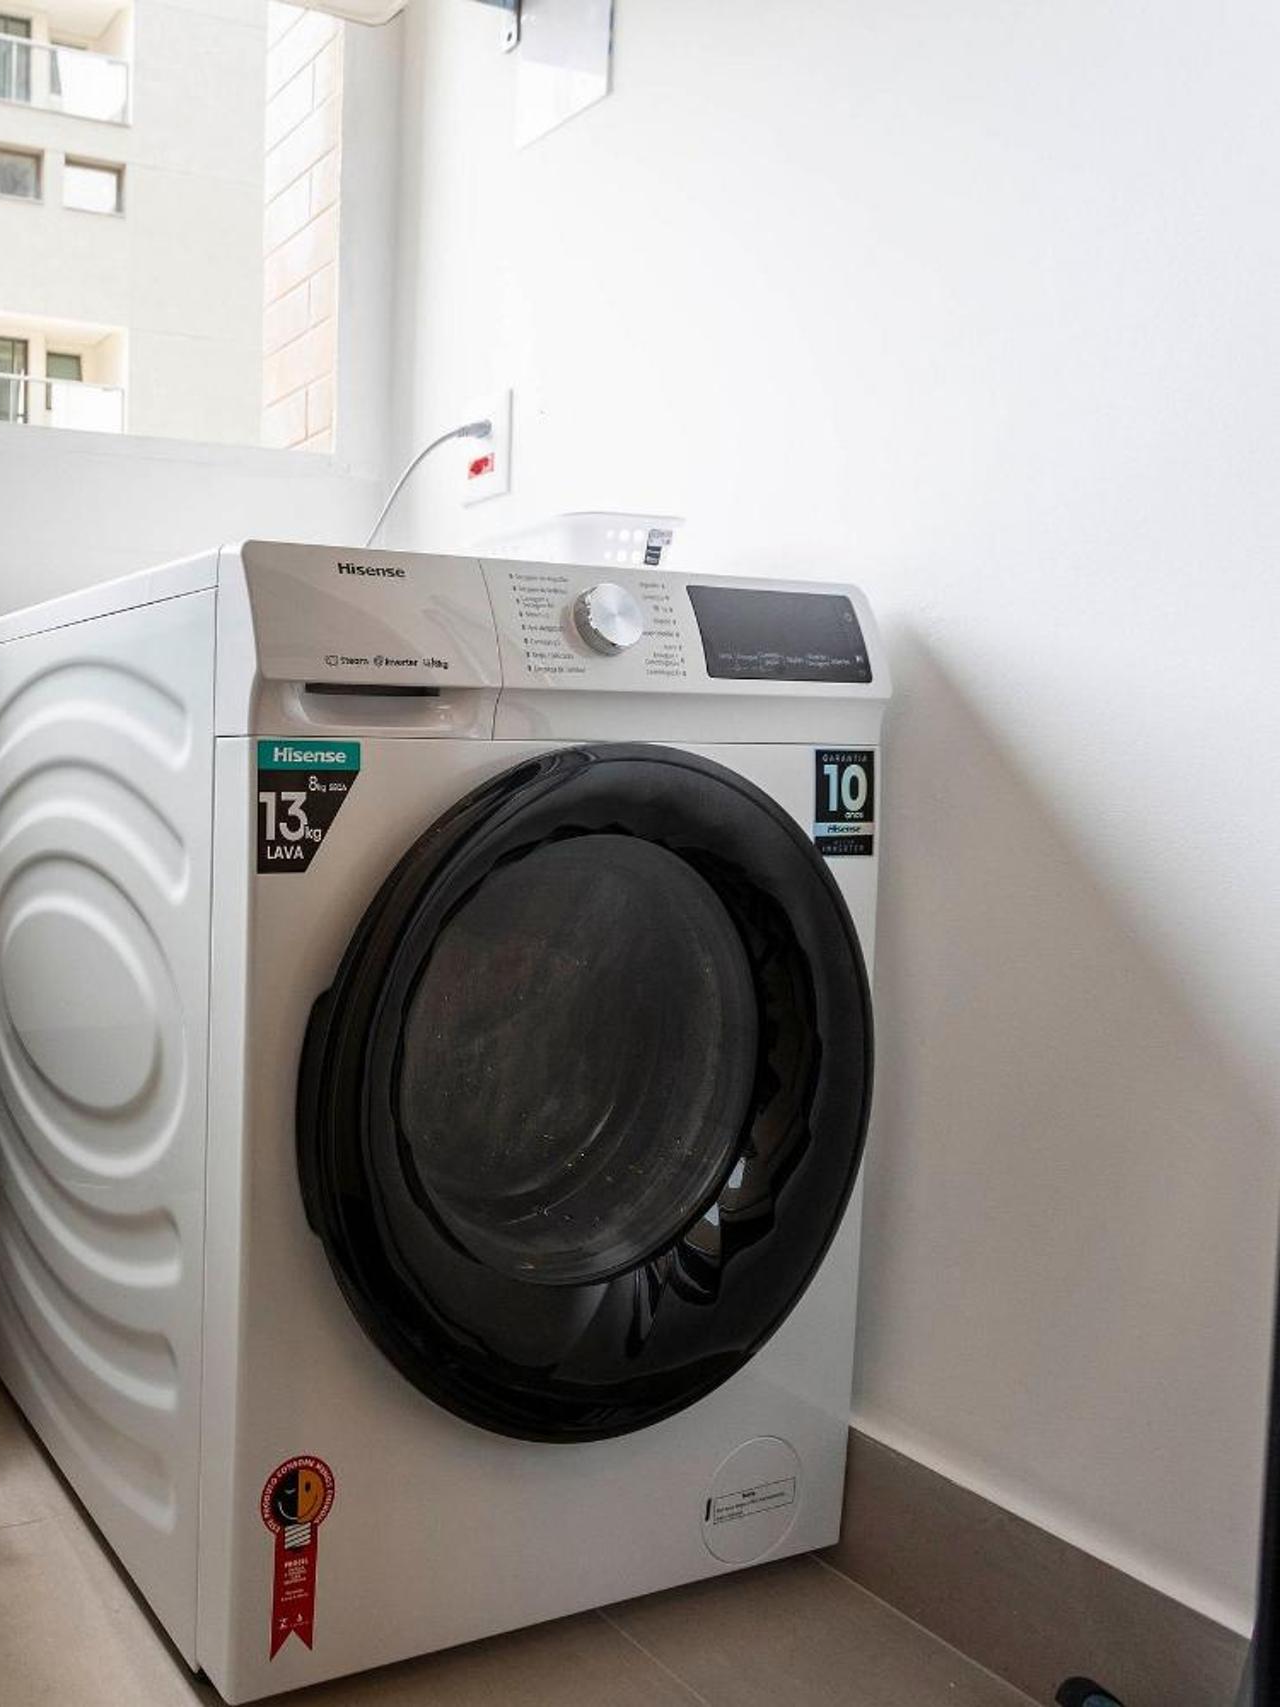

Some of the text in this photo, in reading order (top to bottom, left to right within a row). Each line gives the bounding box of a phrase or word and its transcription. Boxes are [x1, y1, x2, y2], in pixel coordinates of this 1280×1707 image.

[337, 562, 406, 578] Hisense
[384, 656, 418, 668] Inverter
[273, 747, 348, 763] Hisense
[823, 764, 868, 812] 10
[267, 846, 305, 860] LAVA
